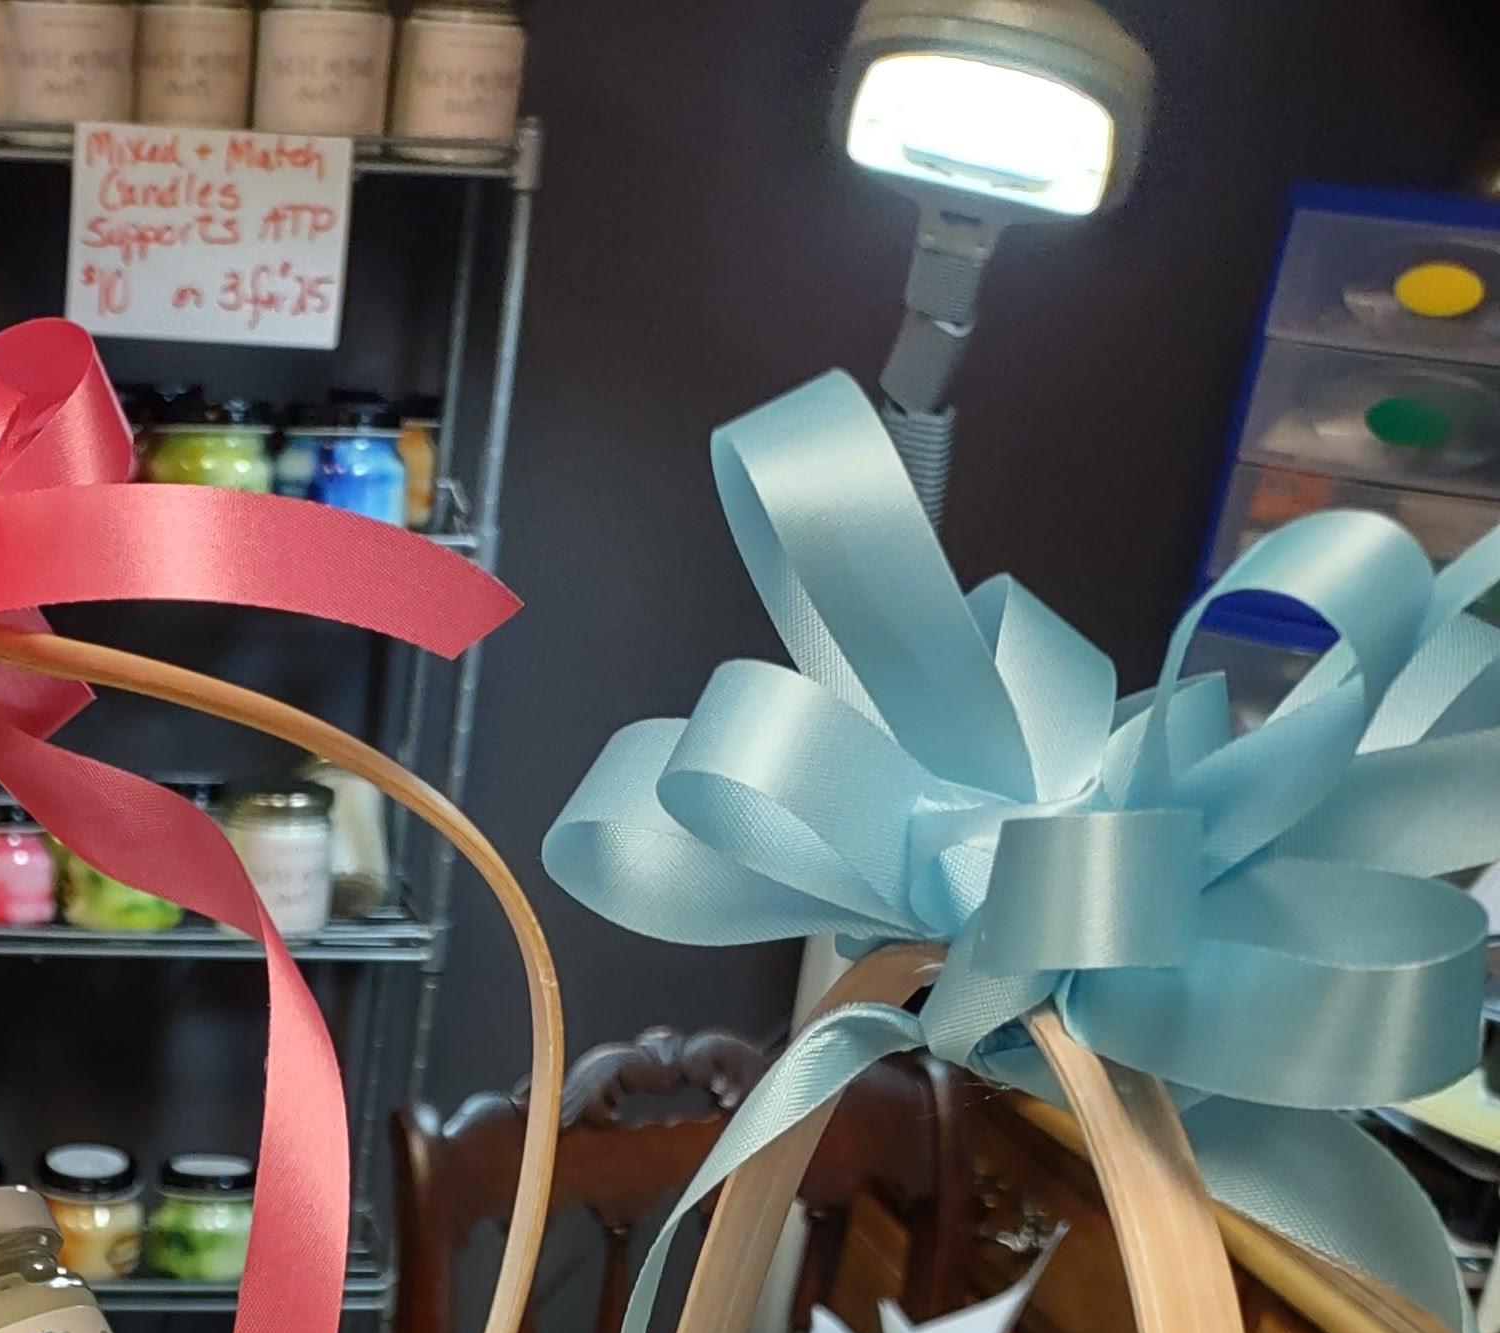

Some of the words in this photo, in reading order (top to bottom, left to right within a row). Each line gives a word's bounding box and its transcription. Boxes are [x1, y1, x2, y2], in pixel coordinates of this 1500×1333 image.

[85, 131, 184, 170] Mixed
[225, 135, 326, 181] Match
[99, 169, 243, 212] Candles
[81, 215, 243, 266] Supports
[258, 203, 338, 243] ATP
